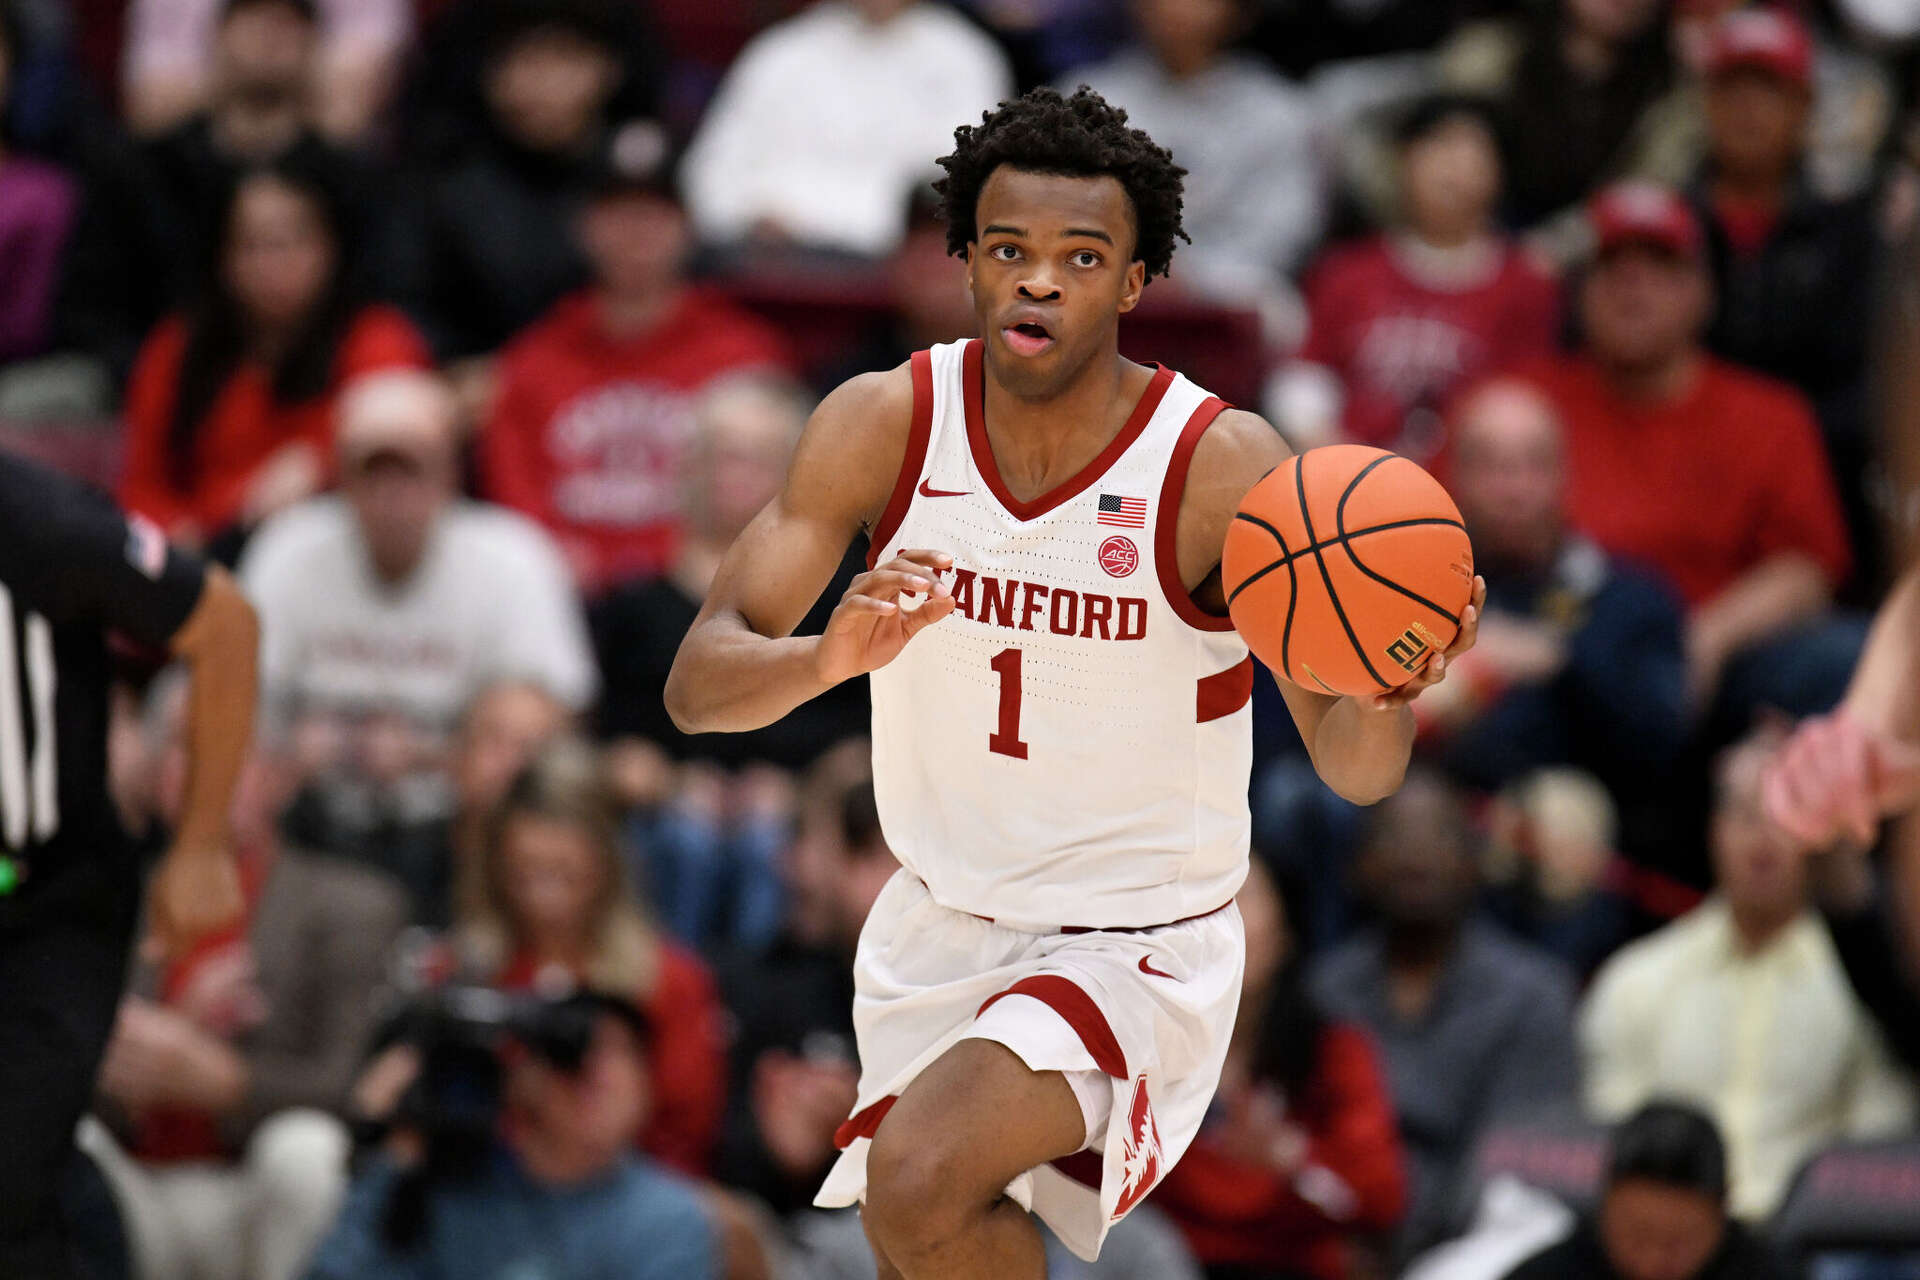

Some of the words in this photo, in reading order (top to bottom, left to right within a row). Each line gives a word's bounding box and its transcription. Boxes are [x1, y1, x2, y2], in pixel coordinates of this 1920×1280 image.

[897, 549, 1148, 641] ANFORD
[1103, 549, 1136, 560] ACC
[989, 648, 1028, 760] 1
